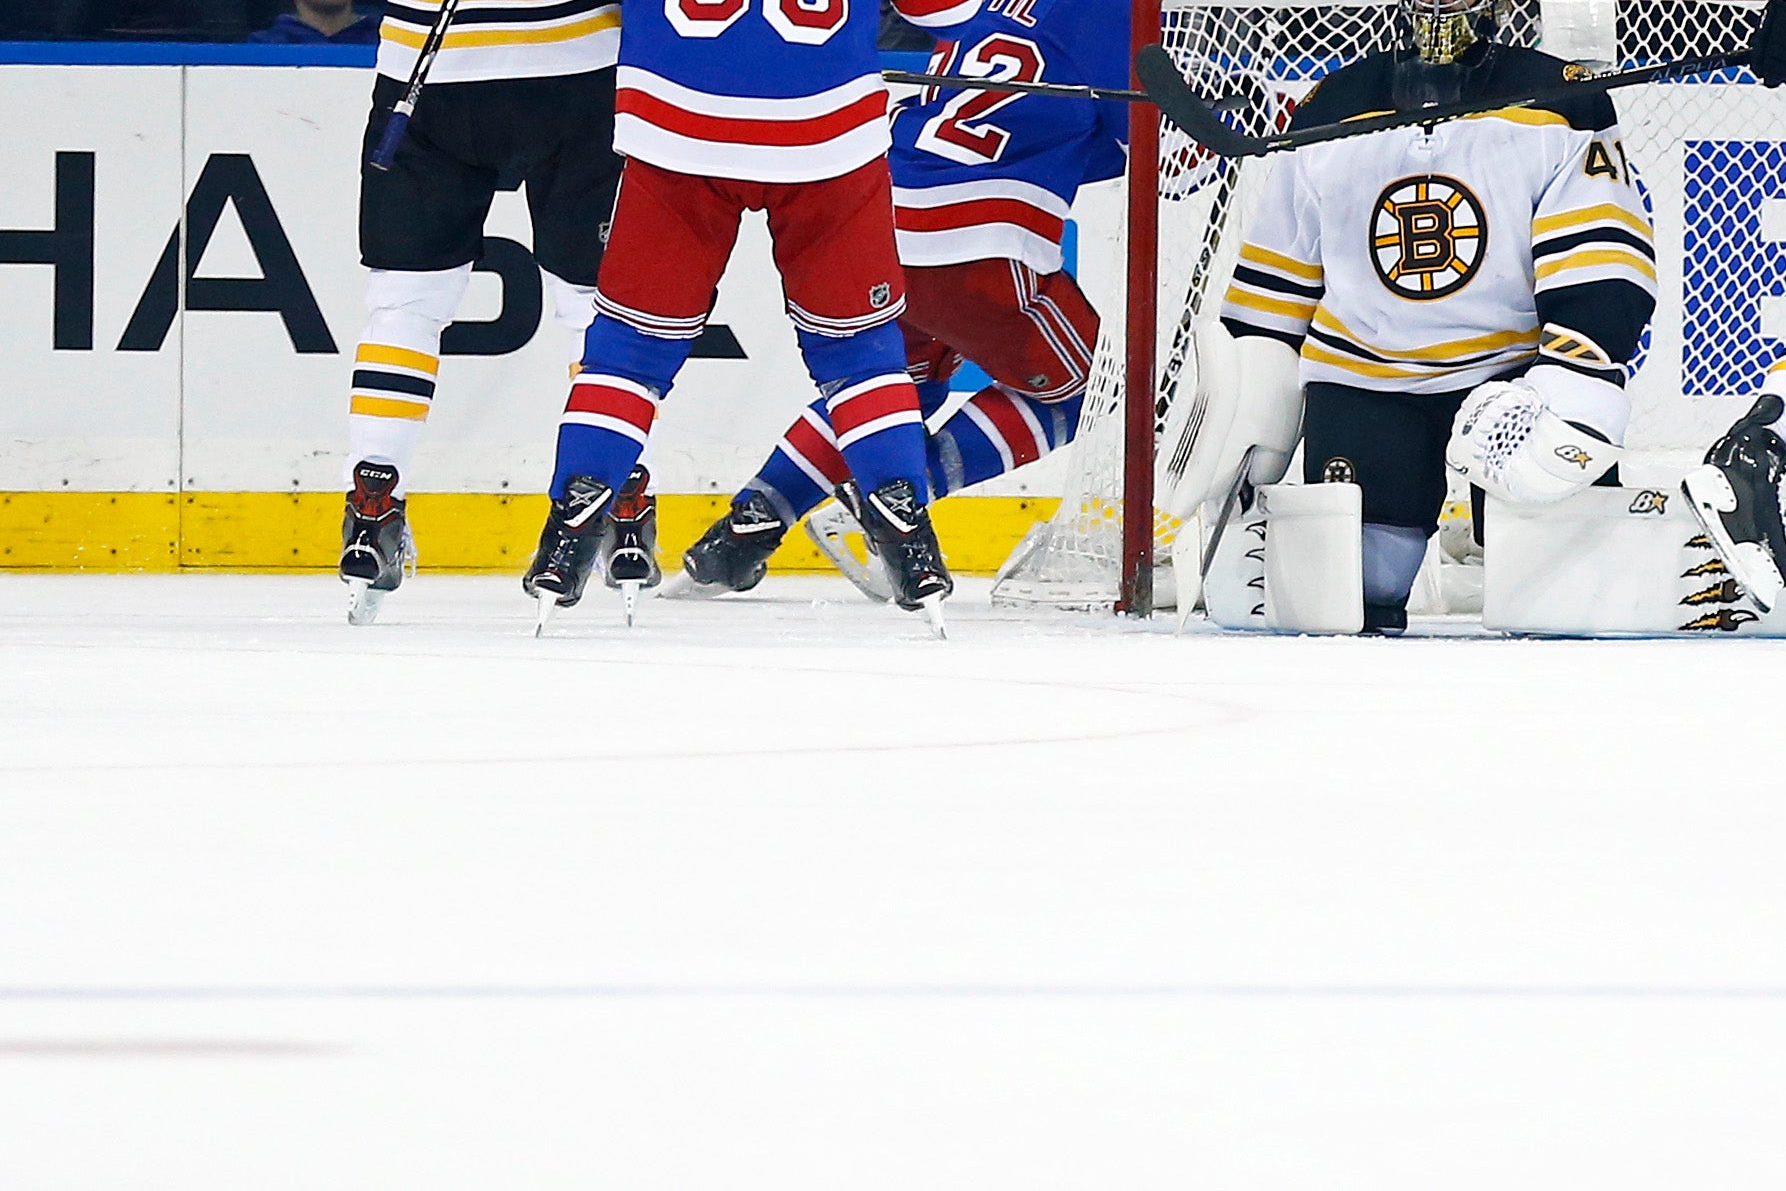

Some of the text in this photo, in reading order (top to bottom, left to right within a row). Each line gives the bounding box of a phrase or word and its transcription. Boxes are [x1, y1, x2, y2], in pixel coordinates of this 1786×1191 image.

[1650, 59, 1727, 81] ALPHA
[1395, 197, 1454, 274] B
[359, 468, 394, 480] CCM
